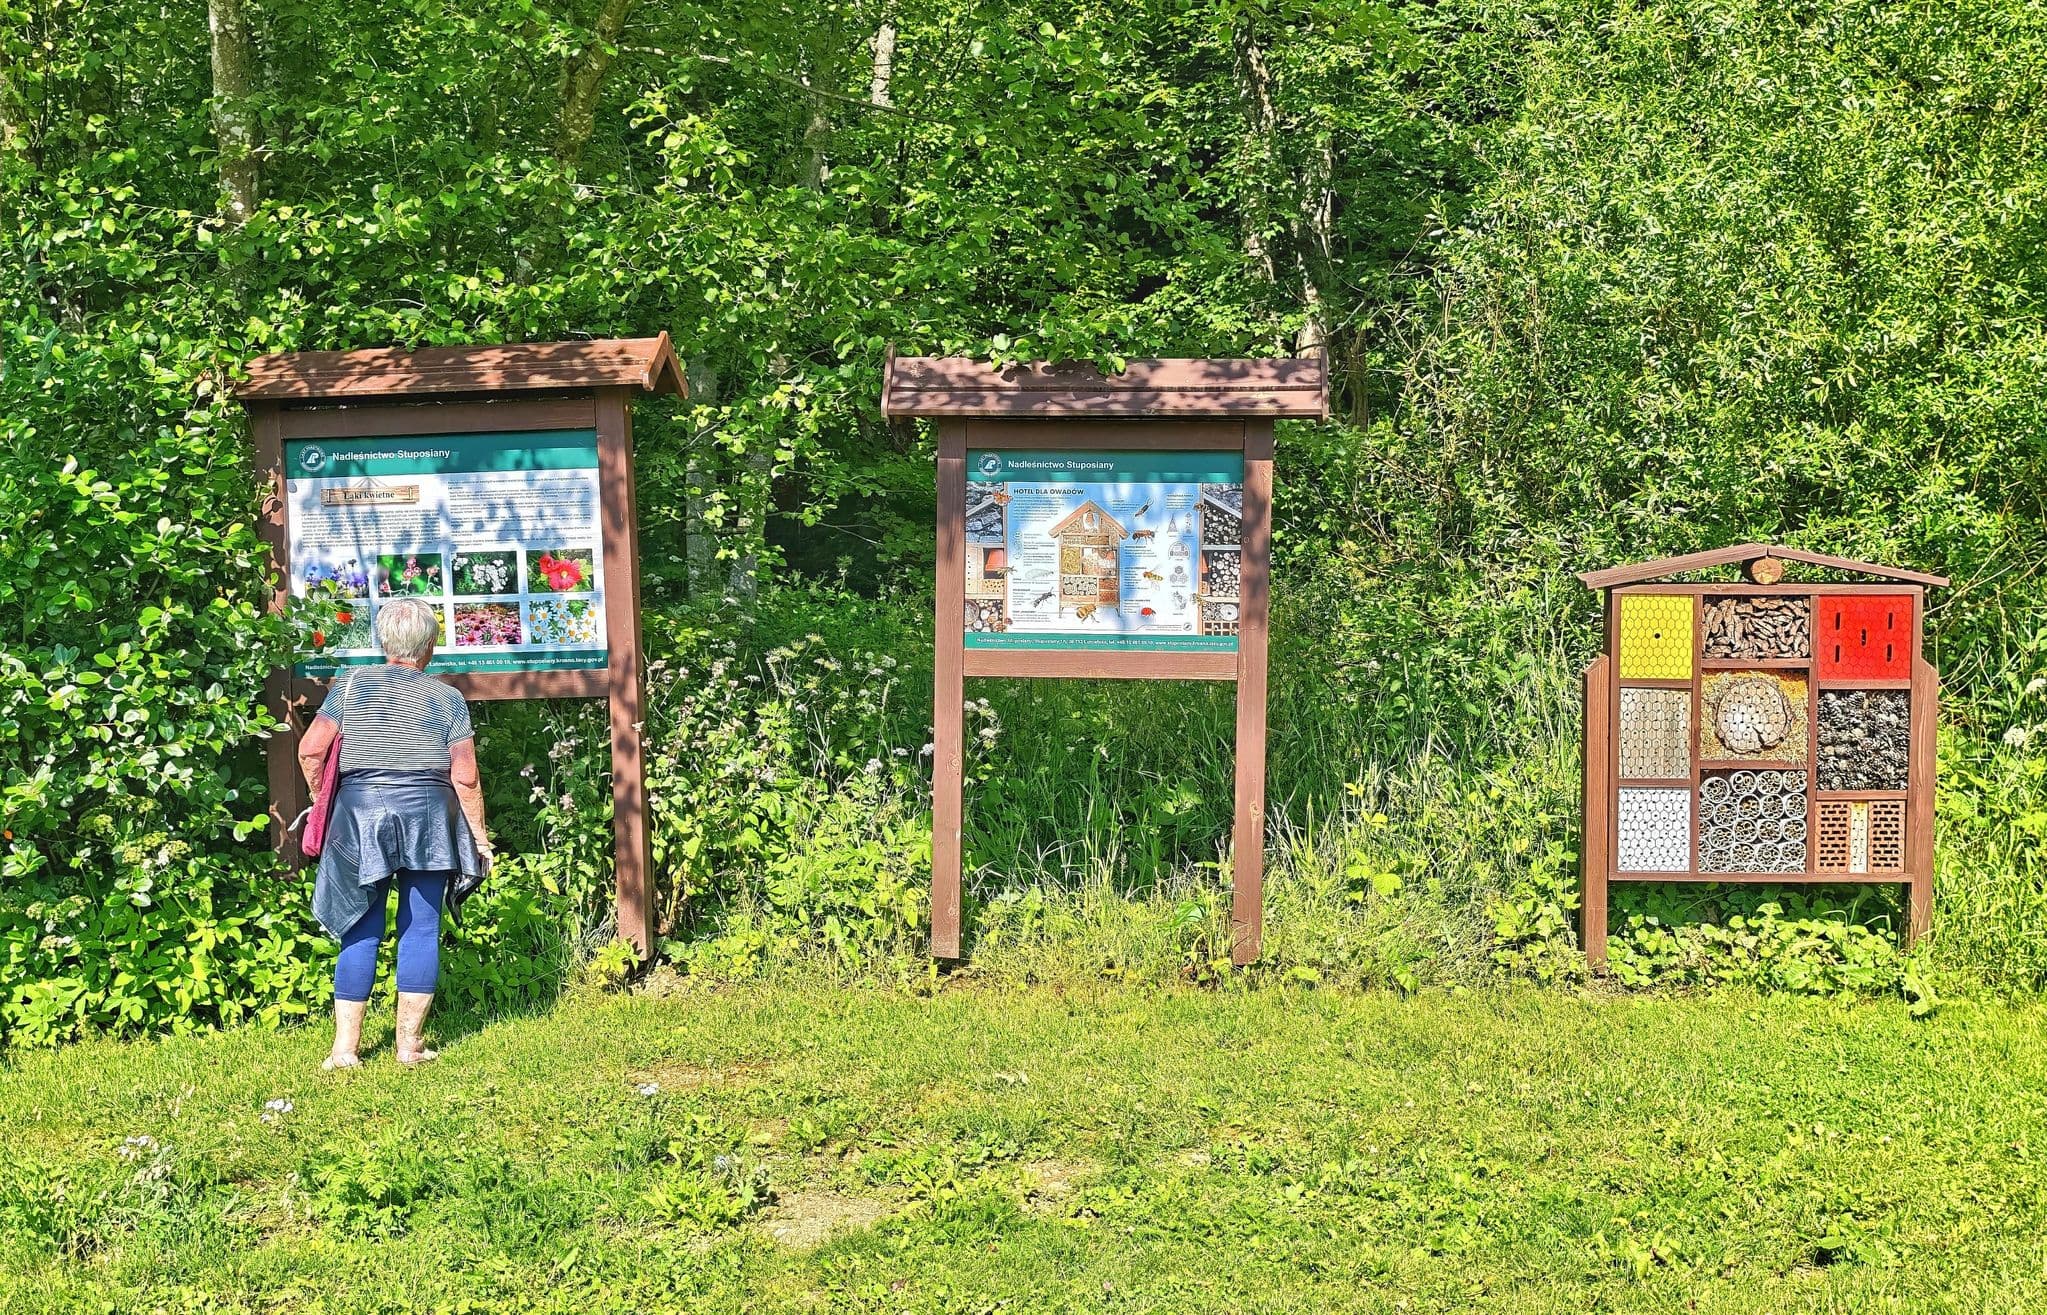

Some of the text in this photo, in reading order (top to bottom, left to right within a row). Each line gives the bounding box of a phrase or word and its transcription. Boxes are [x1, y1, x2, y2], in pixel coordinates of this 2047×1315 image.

[332, 450, 395, 462] Nadleśnictwo
[397, 448, 451, 460] Stuposiany
[1008, 460, 1064, 469] Nadleśnictwo
[1066, 460, 1114, 471] Stuposiany
[364, 489, 395, 499] kwietne
[1050, 487, 1084, 495] OWADÓW
